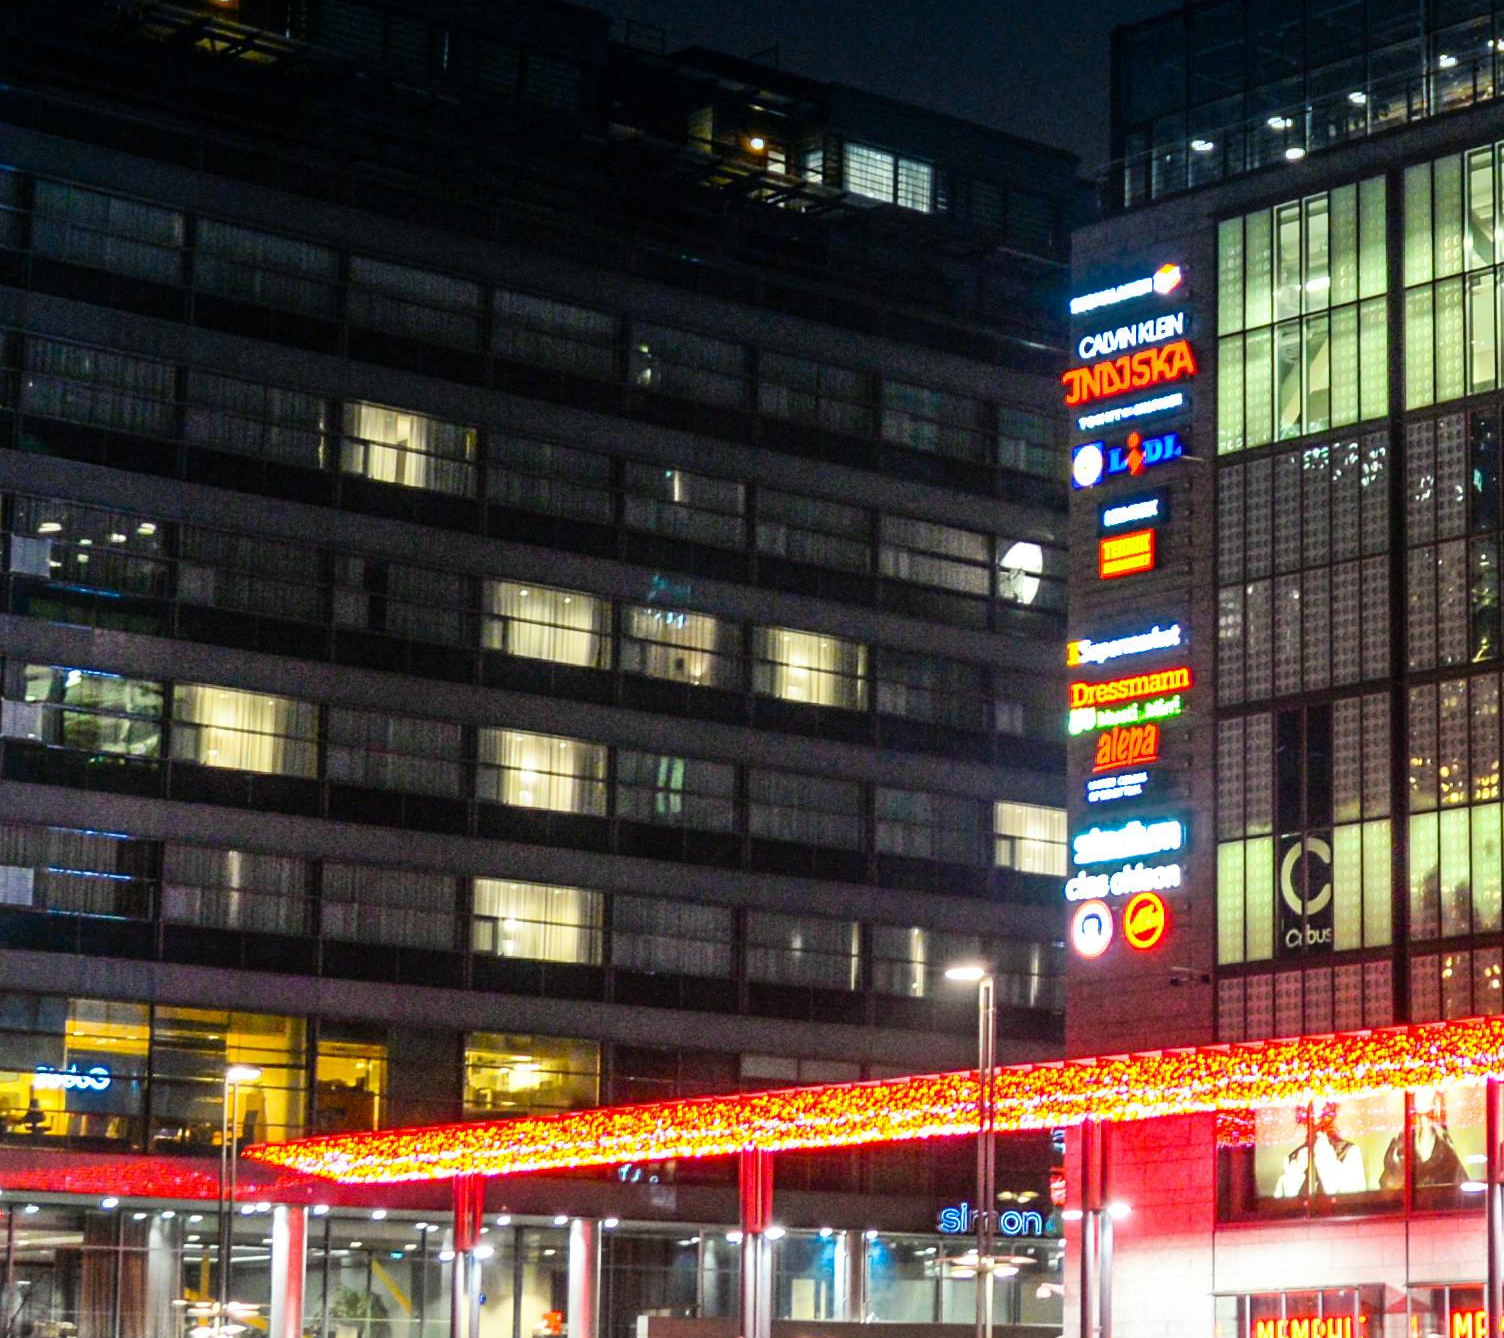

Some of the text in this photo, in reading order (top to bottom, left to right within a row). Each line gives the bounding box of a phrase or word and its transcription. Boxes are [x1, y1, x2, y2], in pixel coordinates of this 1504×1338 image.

[1078, 311, 1184, 359] CALVIN KLEIN
[1061, 339, 1196, 405] INDISKA
[1069, 666, 1191, 709] Dressmann
[1095, 723, 1160, 767] alepa
